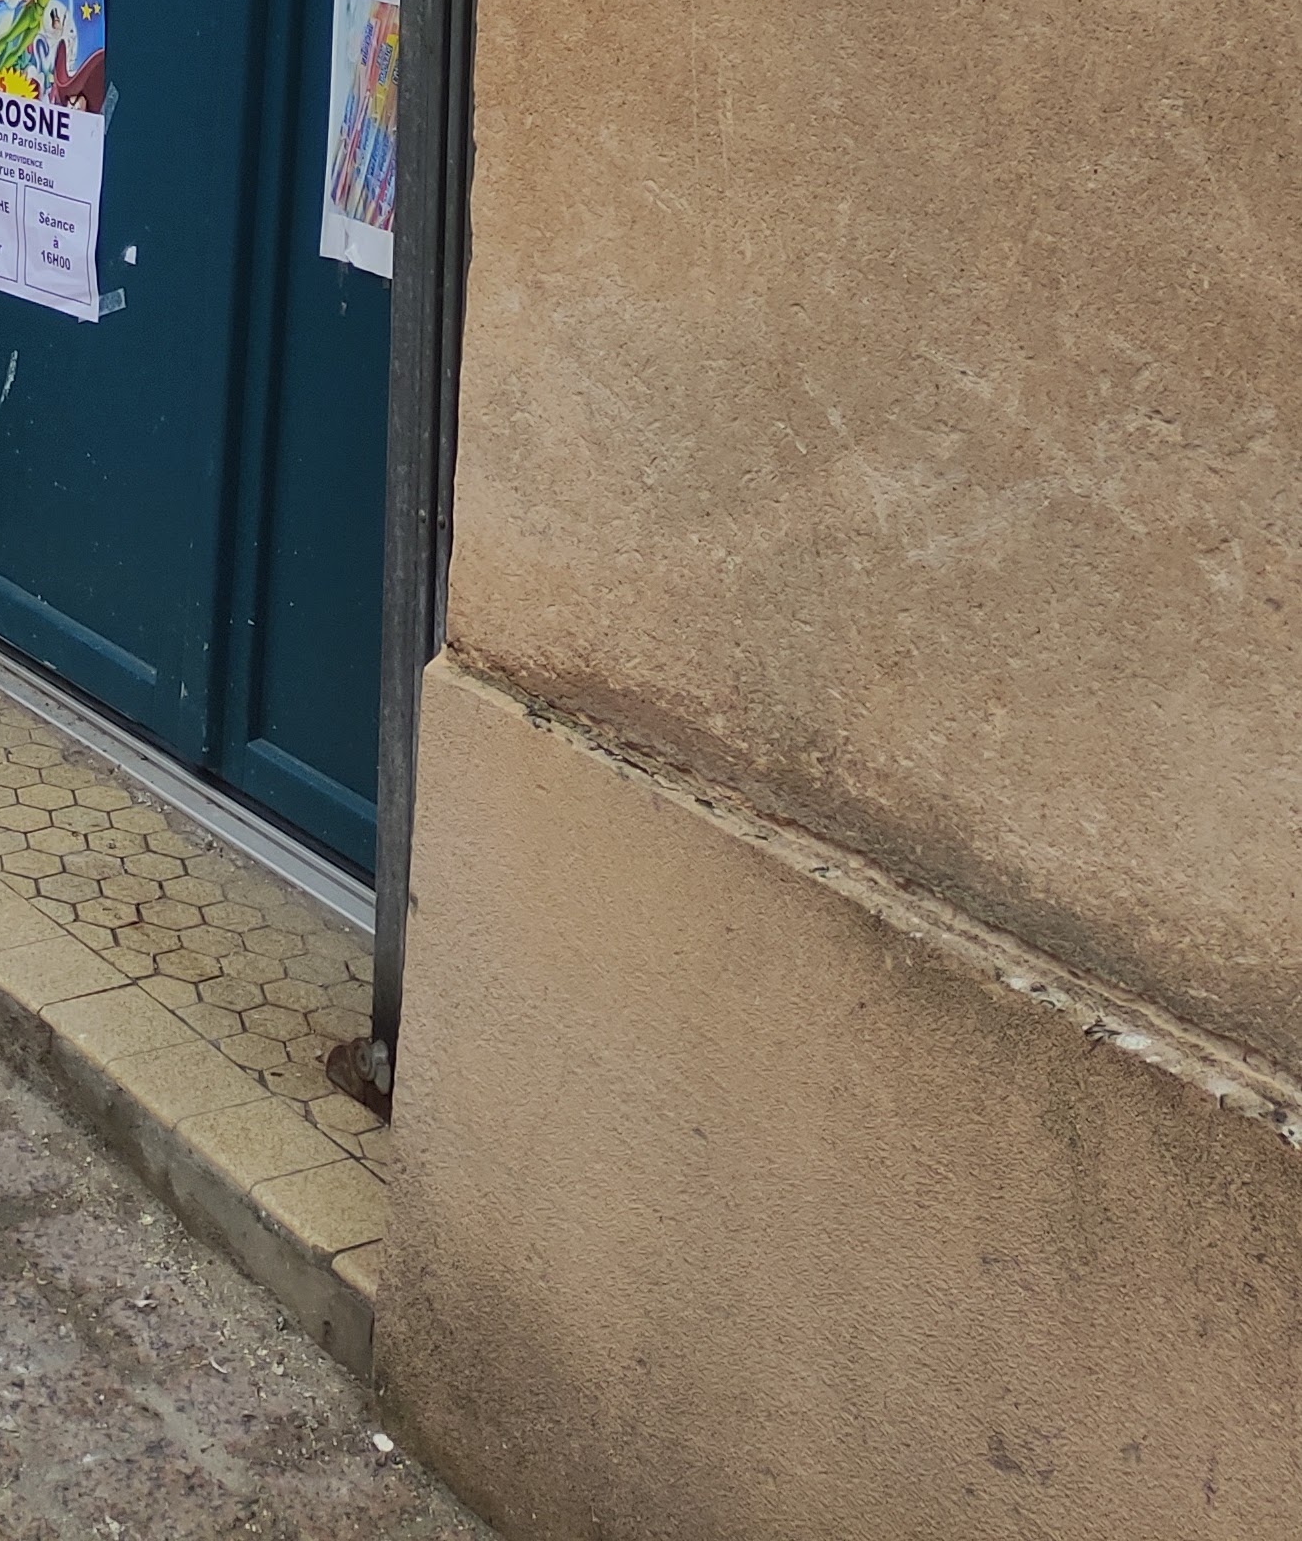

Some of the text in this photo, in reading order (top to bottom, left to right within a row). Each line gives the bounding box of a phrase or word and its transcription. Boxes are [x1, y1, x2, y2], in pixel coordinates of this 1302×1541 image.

[11, 132, 66, 158] Paroissiale
[4, 151, 44, 169] PROVIDENCE
[0, 166, 16, 178] rue
[18, 169, 55, 189] Boileau
[38, 211, 76, 234] Séance
[52, 235, 60, 249] à
[40, 249, 72, 271] 16H00
